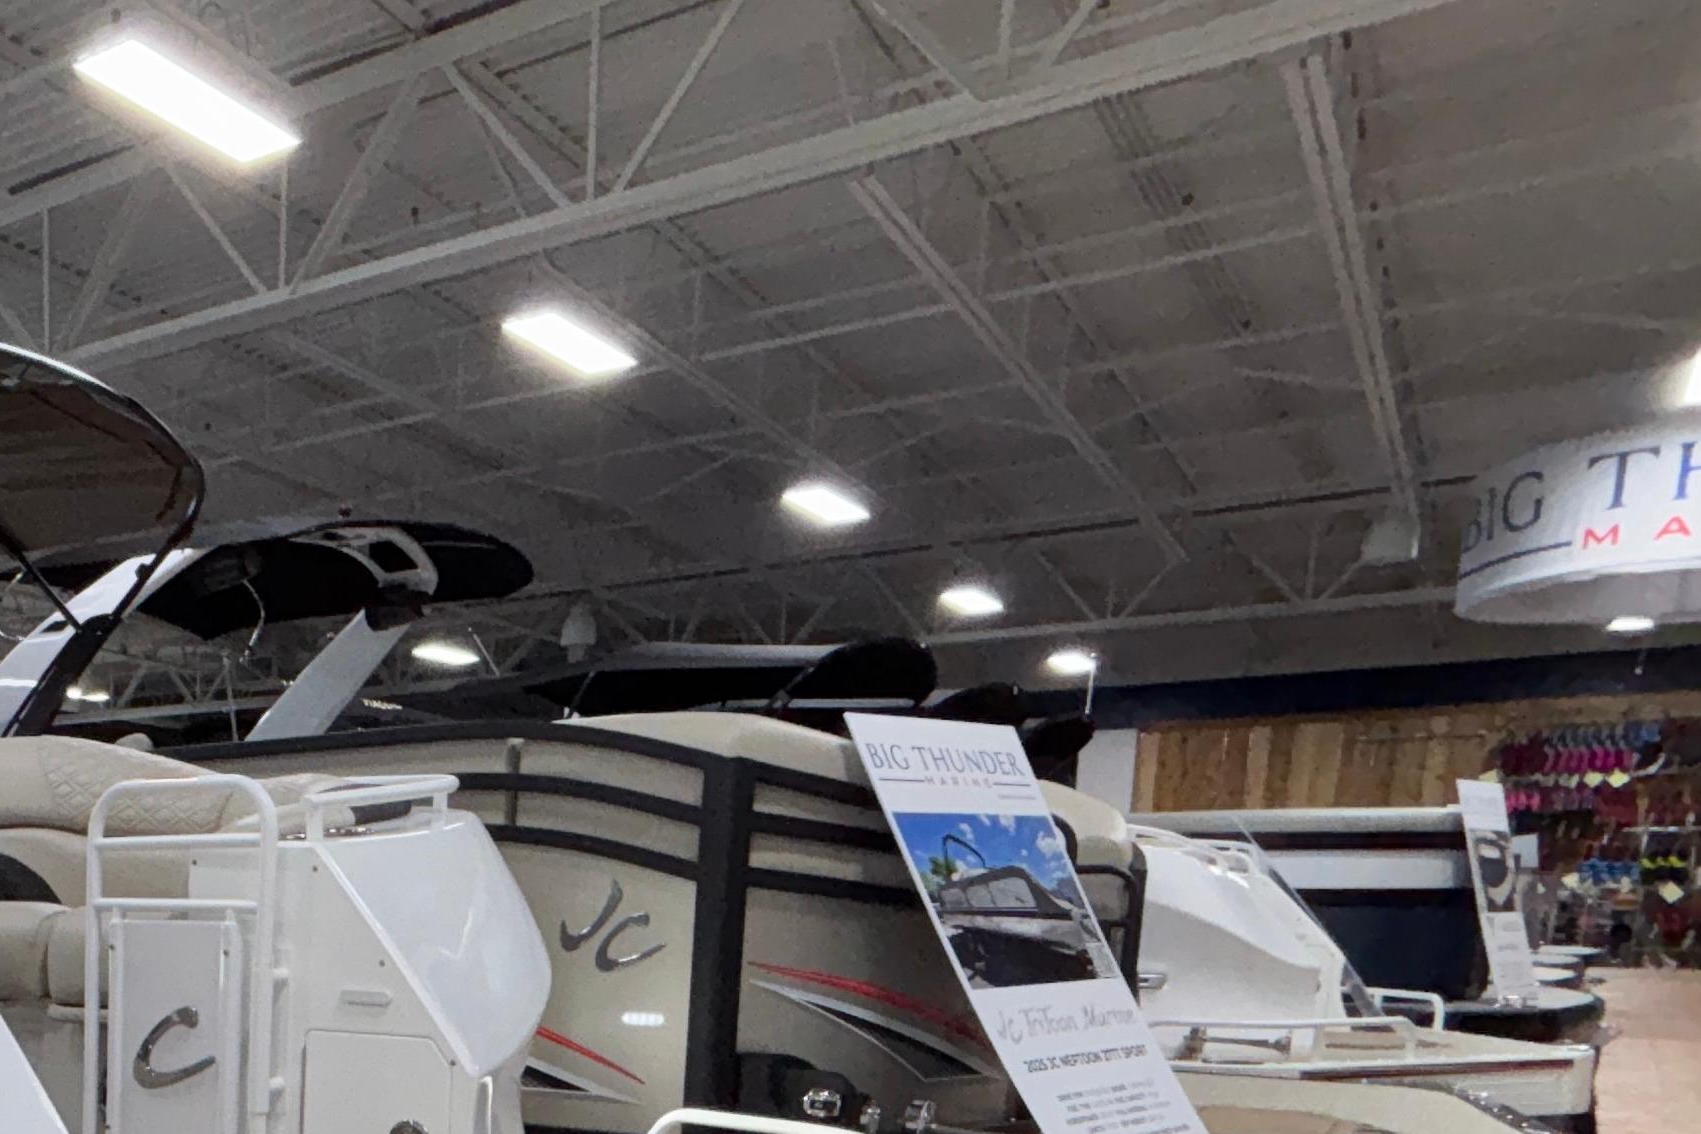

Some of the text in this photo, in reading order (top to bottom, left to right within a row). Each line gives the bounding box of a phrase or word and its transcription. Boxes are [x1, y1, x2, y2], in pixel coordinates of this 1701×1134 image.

[1581, 515, 1692, 550] MA
[865, 743, 1025, 777] BIG THUNDER
[924, 776, 993, 789] MARINE
[560, 878, 667, 972] JC
[1121, 1044, 1146, 1059] SPORT
